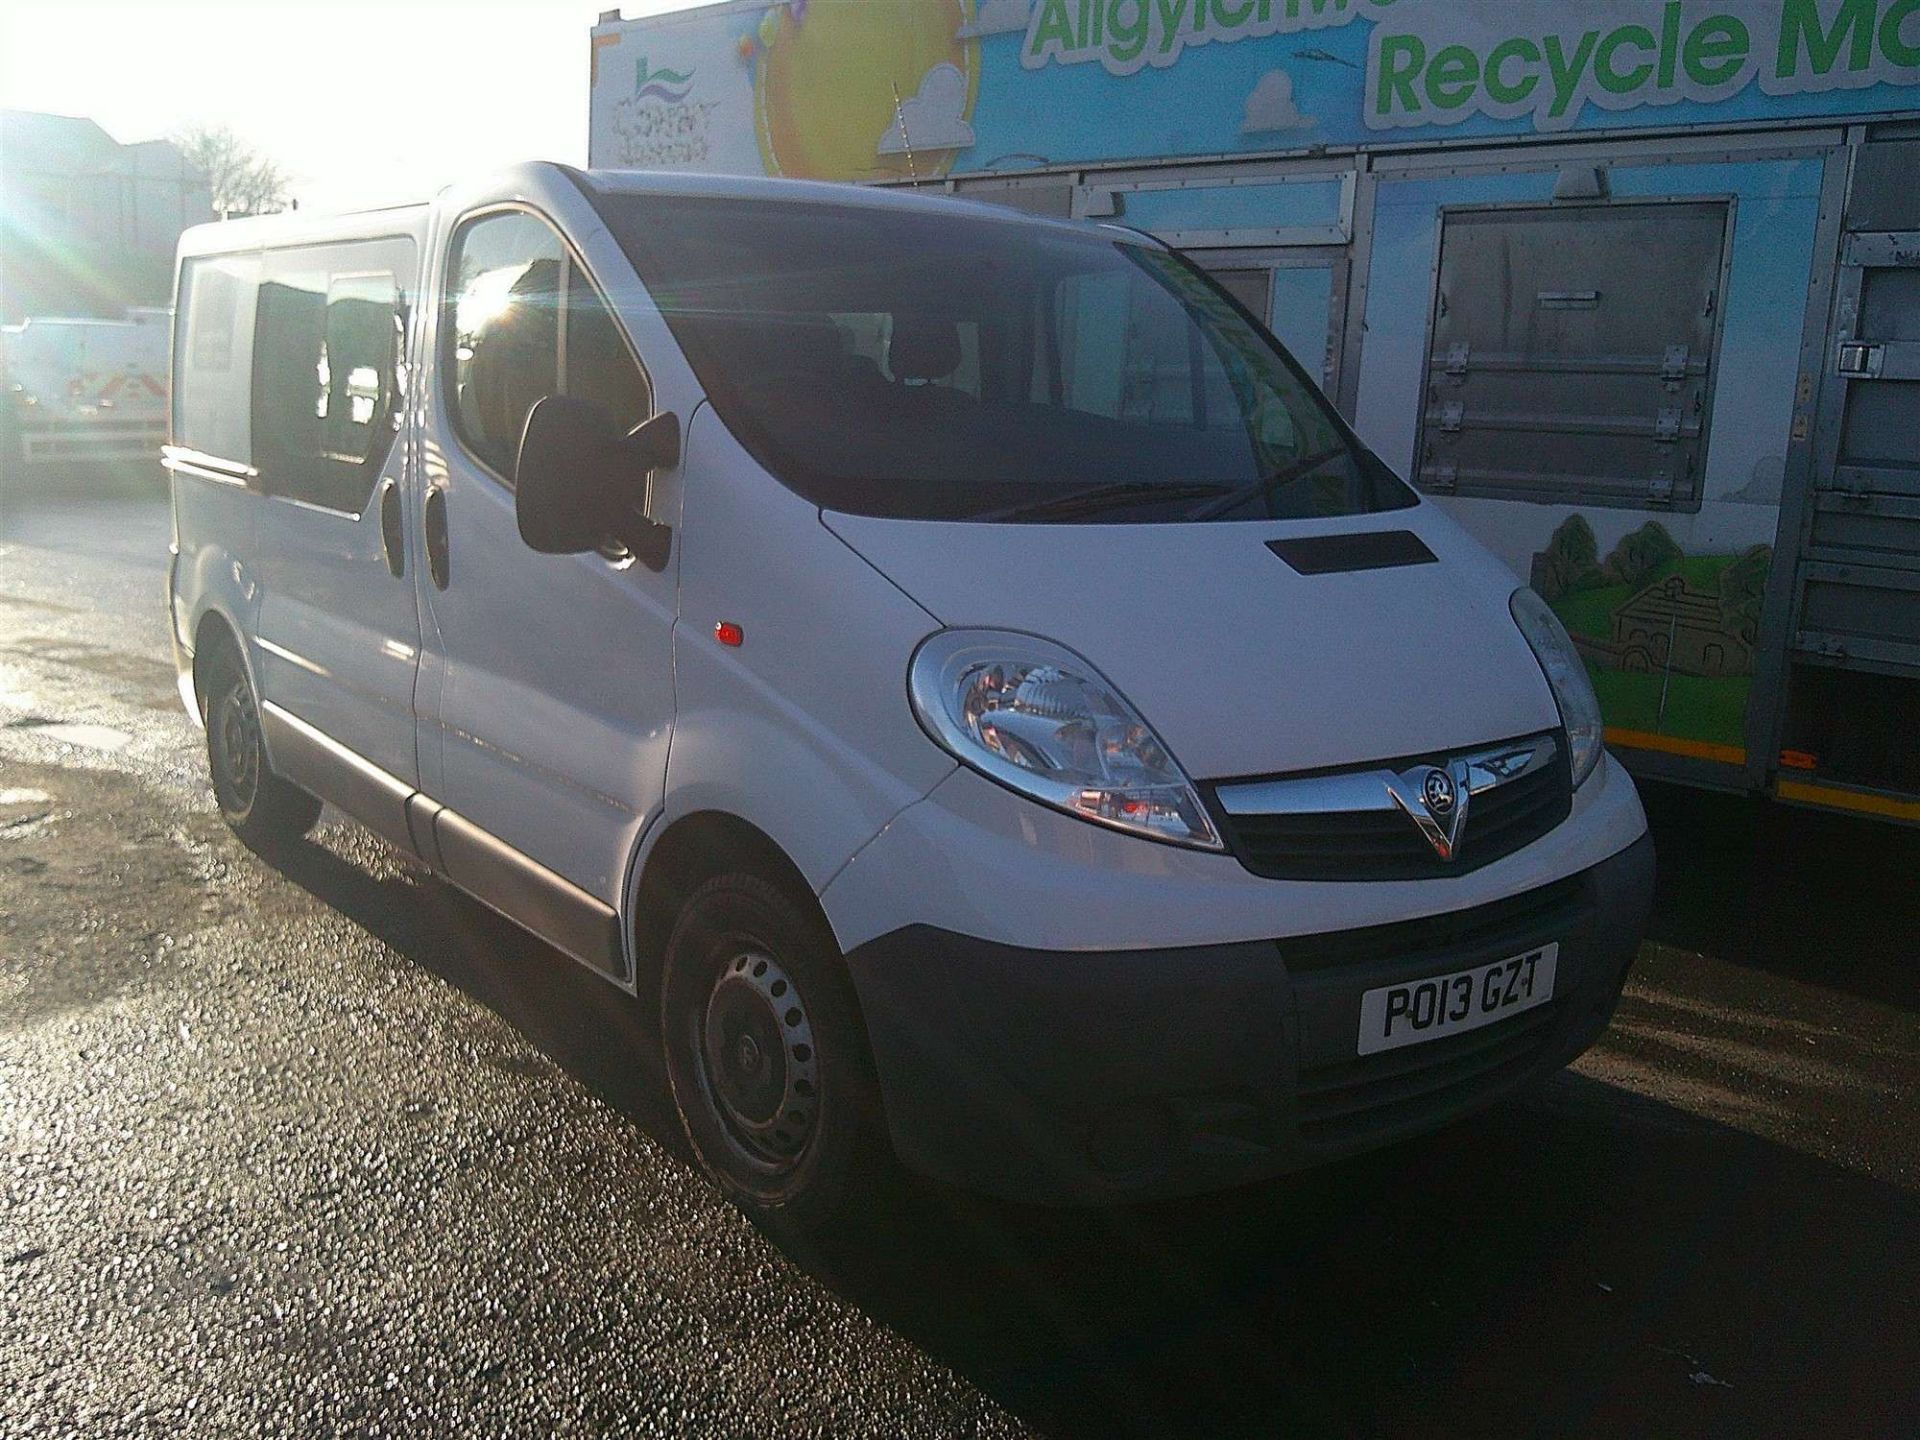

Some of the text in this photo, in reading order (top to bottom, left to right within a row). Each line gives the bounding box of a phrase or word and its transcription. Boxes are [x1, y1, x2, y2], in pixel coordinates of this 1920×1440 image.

[1376, 0, 1750, 118] Recycle
[1384, 951, 1543, 1037] PO13 GZT
